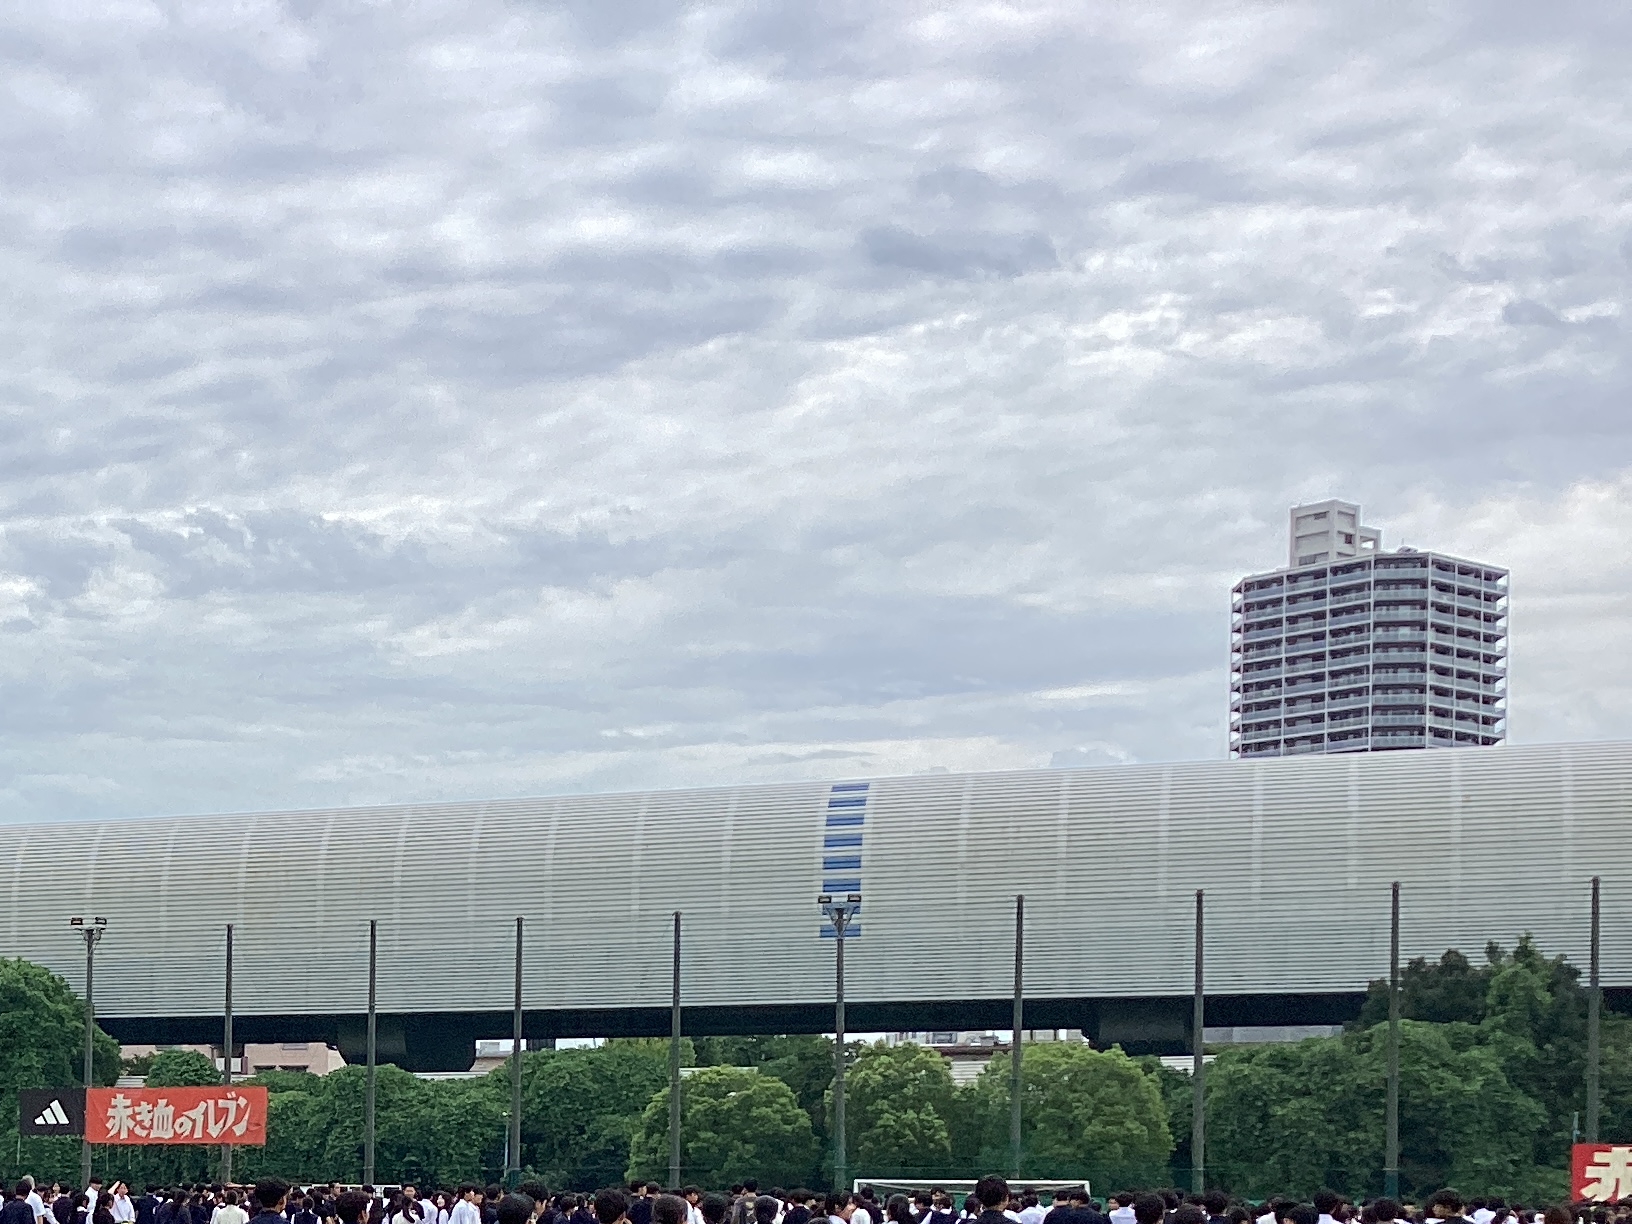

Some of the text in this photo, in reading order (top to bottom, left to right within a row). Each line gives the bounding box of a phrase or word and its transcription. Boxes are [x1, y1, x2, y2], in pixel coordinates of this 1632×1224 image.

[105, 1091, 252, 1139] 赤き血のイレブン
